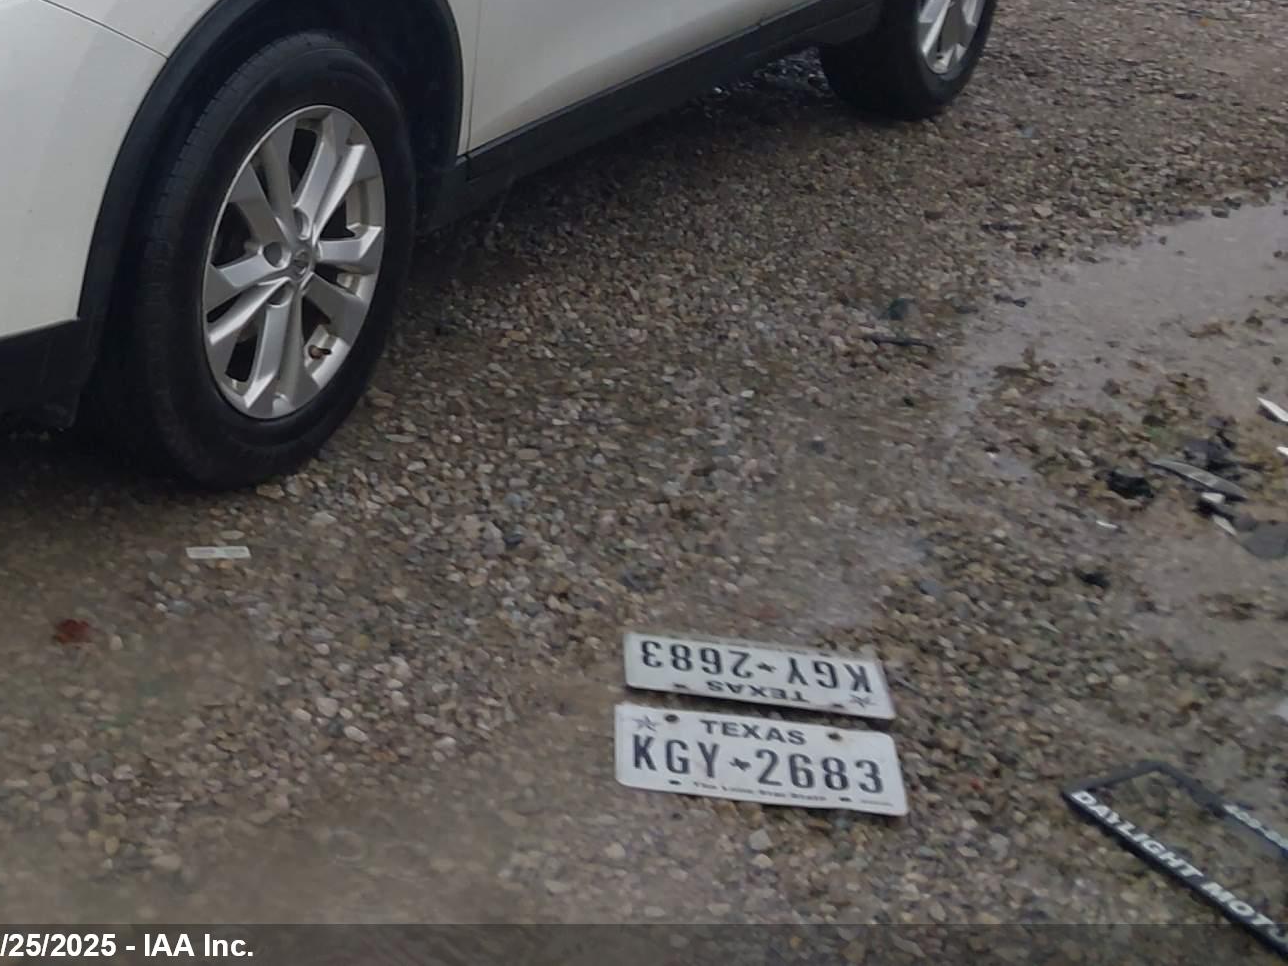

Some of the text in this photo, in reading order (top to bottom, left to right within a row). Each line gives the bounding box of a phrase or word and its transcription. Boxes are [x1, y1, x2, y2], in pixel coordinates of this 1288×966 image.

[707, 680, 809, 703] TEXAS
[700, 719, 806, 746] TEXAS
[1071, 790, 1204, 878] DAYLIGHT
